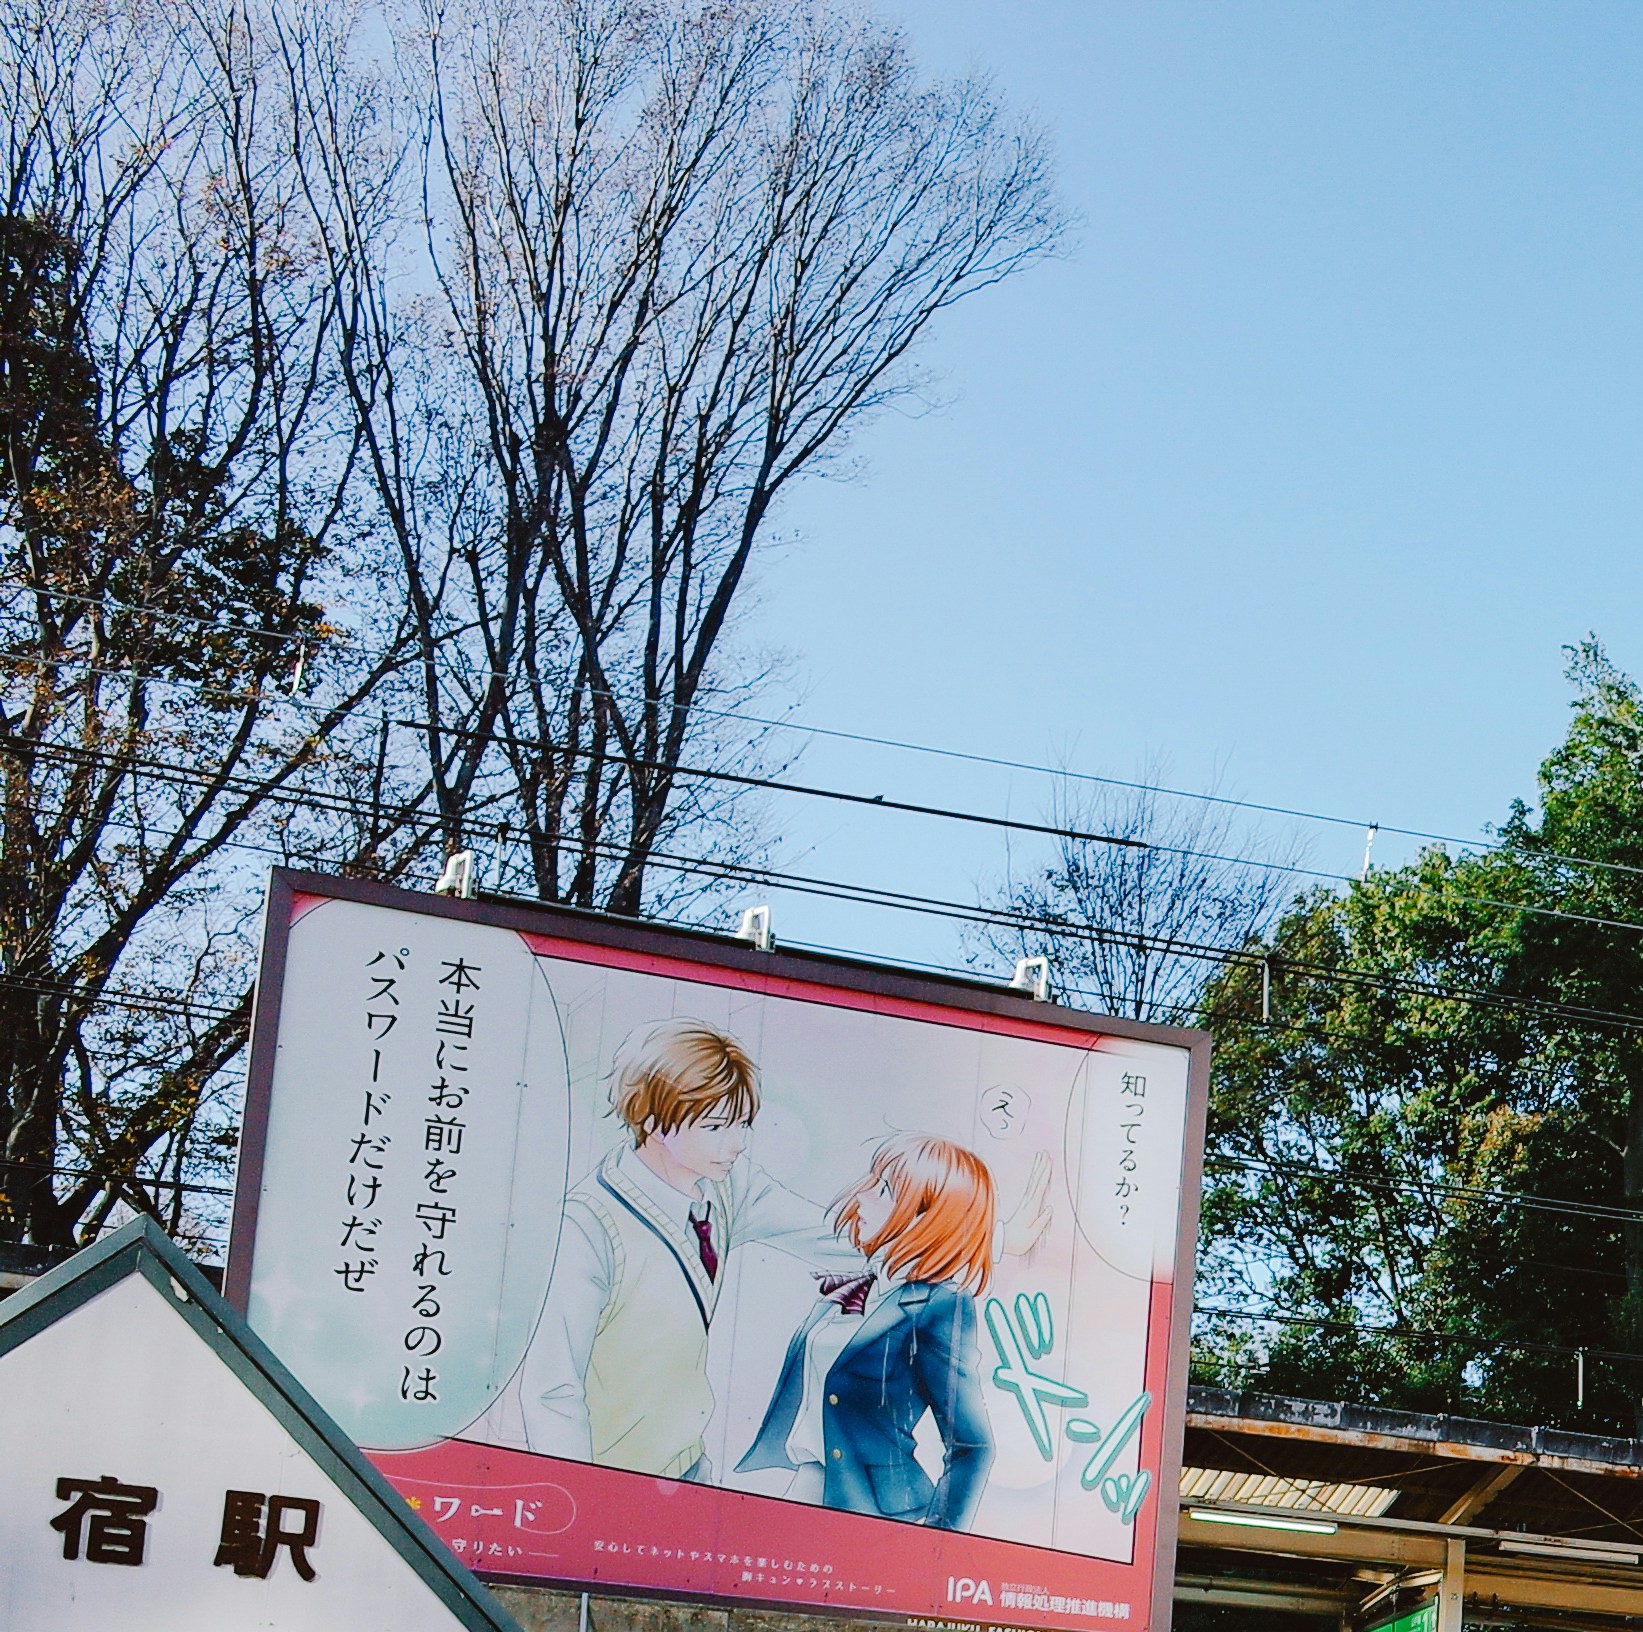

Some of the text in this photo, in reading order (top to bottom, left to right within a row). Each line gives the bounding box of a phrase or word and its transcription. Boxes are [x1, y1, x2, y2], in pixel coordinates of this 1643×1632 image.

[333, 946, 410, 1293] パスワードだけだぜ
[400, 957, 482, 1402] 本当にお前を守れるのは
[1114, 1071, 1147, 1226] 知ってるか？
[49, 1473, 321, 1582] 宿駅
[946, 1575, 994, 1607] IPA
